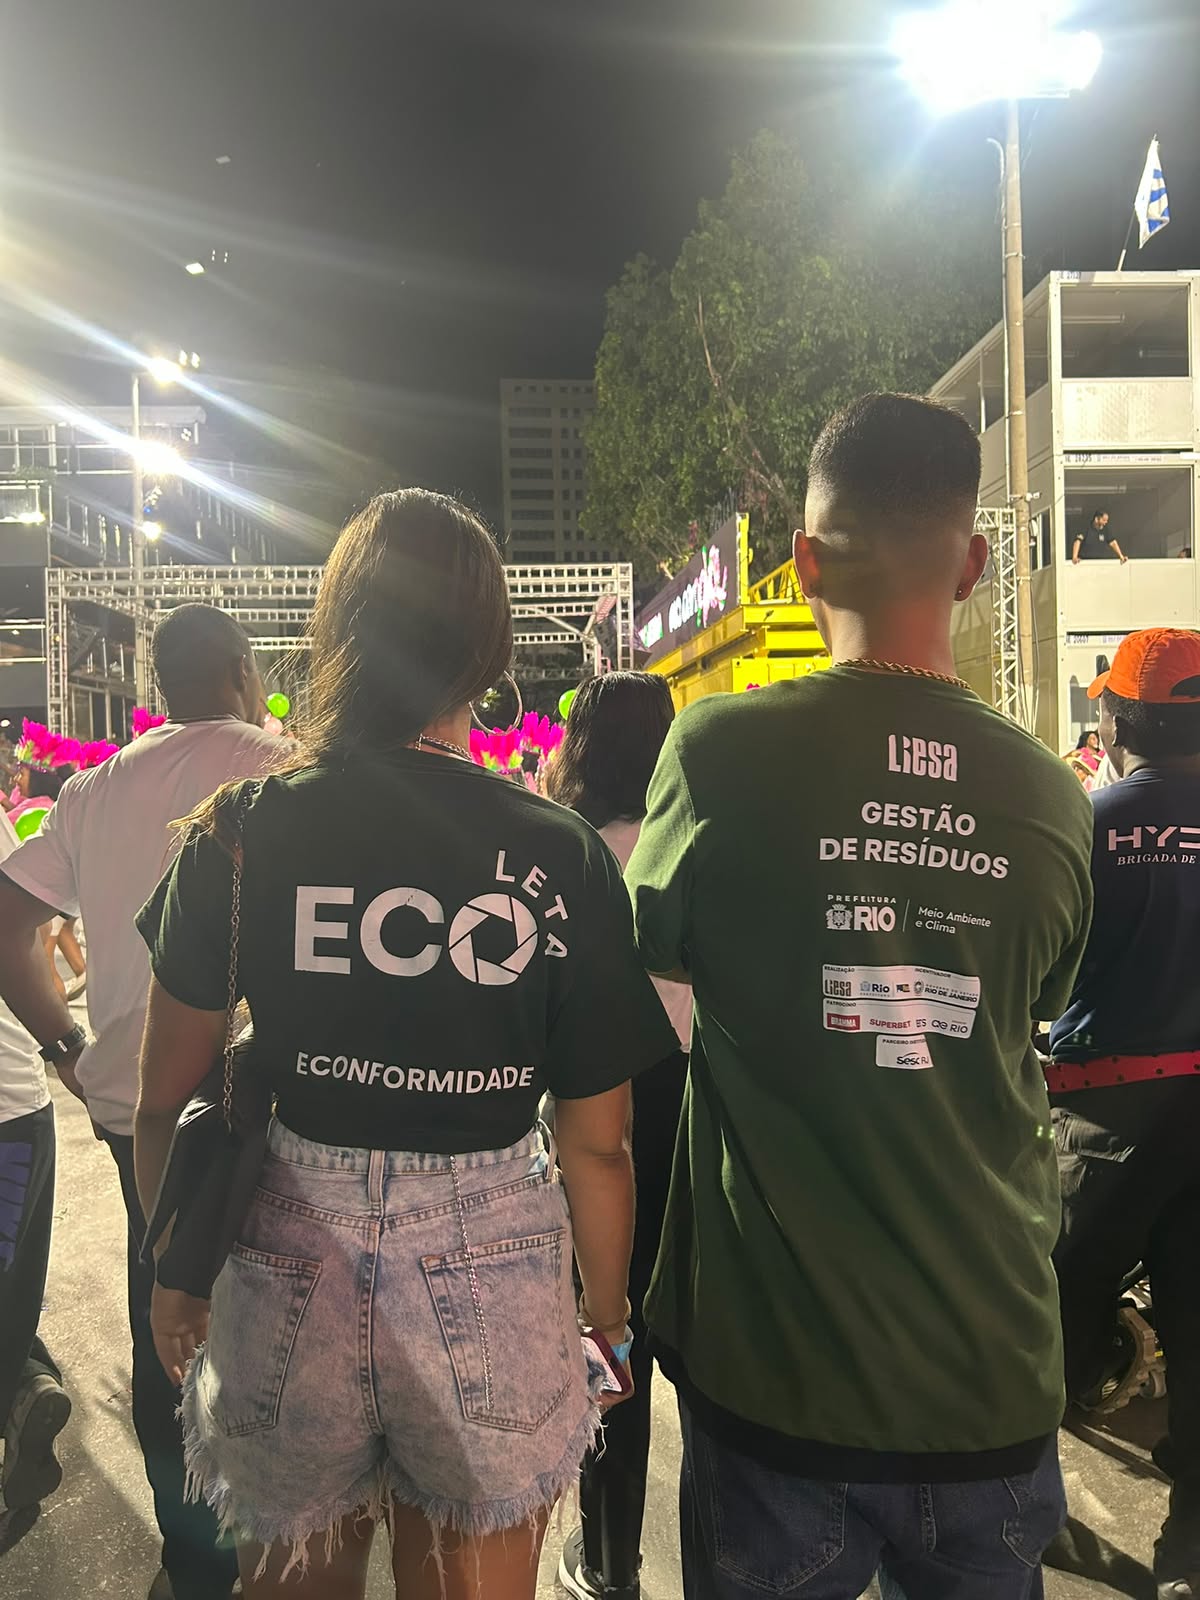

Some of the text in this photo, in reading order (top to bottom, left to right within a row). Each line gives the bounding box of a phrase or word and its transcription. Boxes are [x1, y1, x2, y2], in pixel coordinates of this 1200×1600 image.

[861, 801, 976, 836] GESTÃO
[819, 836, 1009, 879] DE RESÍDUOS
[1117, 853, 1197, 866] BRIGADA DE
[827, 894, 897, 904] PREFEITURA
[854, 906, 896, 932] RIO
[918, 905, 992, 928] Meio Ambiente
[915, 920, 956, 934] e Clima
[871, 983, 890, 993] Rio
[924, 986, 938, 995] RIO
[948, 992, 978, 1003] JANEIRO
[869, 1018, 911, 1029] SUPERBET
[950, 1023, 969, 1034] RIO
[296, 1051, 534, 1094] ECONFORMIDADE
